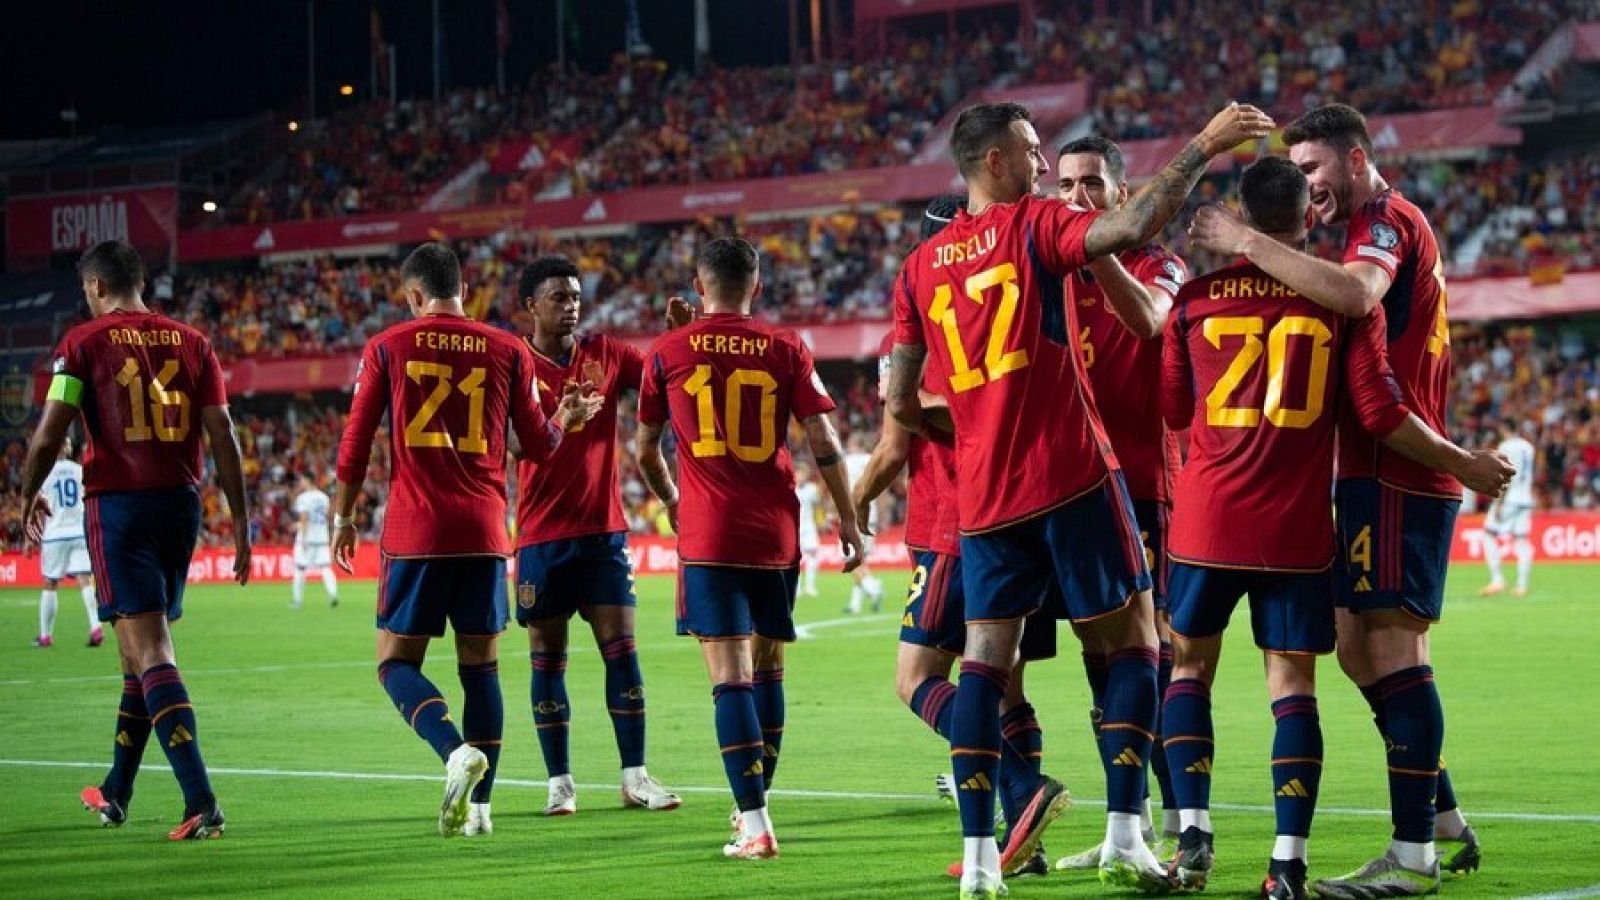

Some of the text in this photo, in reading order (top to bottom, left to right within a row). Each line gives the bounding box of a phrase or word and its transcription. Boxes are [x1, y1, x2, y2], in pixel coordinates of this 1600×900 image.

[52, 196, 128, 249] ESPAÑA
[933, 227, 996, 268] JOSELU
[1209, 277, 1298, 299] CARVA
[109, 328, 181, 346] RODRIGO
[416, 331, 486, 352] FERRAN
[689, 334, 768, 356] YEREMY
[928, 262, 1029, 393] 12
[1203, 316, 1332, 427] 20
[116, 357, 190, 442] 16
[405, 360, 487, 454] 21
[682, 364, 777, 463] 10
[53, 478, 78, 507] 19
